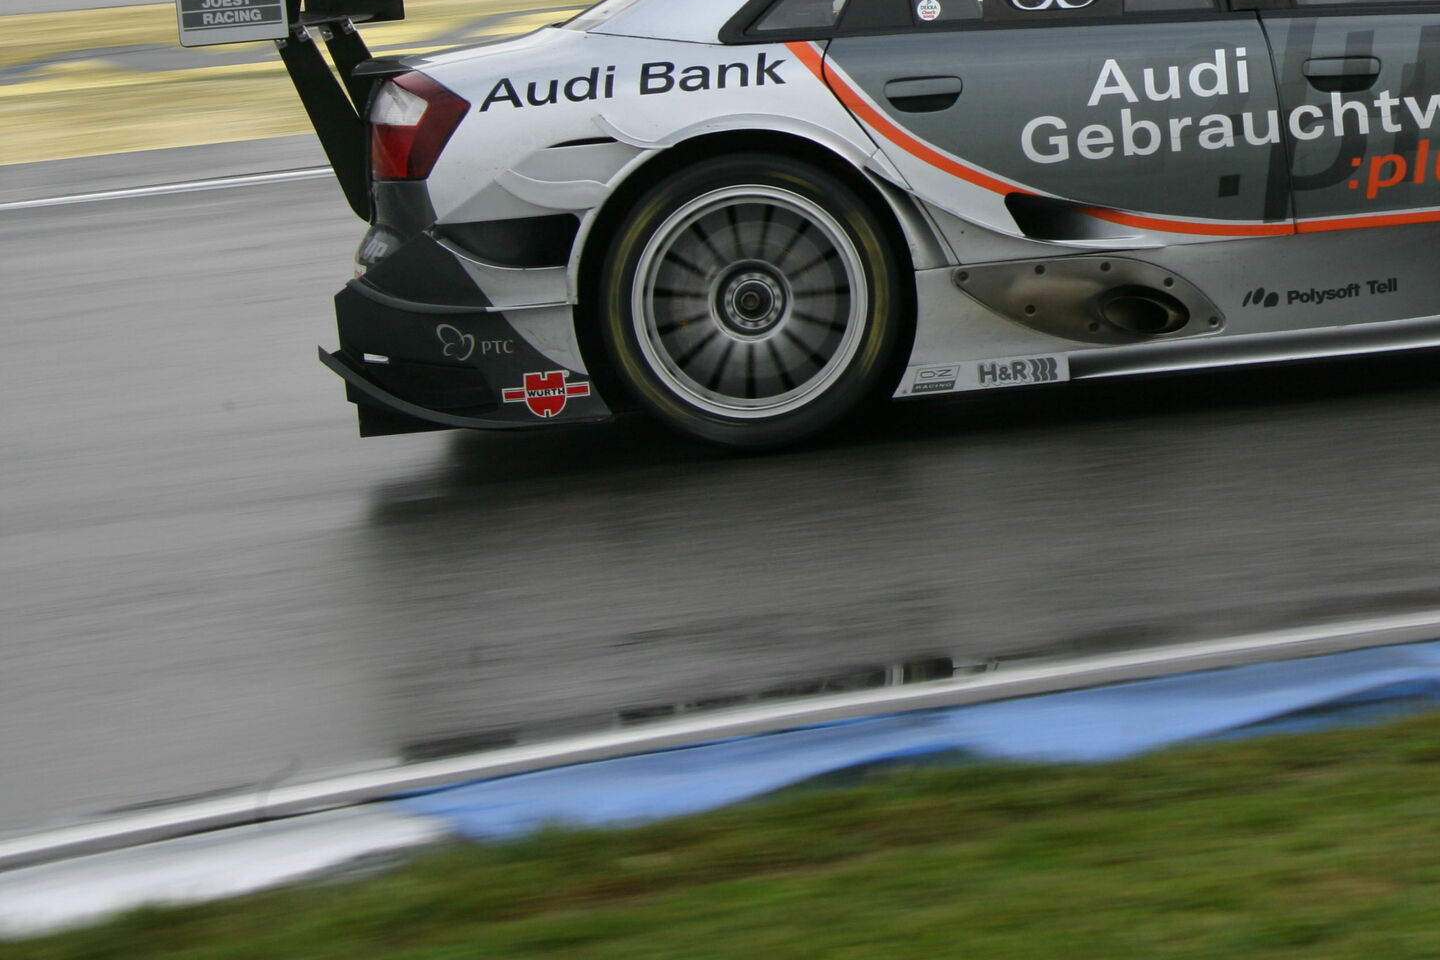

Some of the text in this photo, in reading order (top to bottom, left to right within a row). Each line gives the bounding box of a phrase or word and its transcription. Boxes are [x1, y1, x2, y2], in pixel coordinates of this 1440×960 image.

[202, 8, 262, 25] RACING
[479, 52, 788, 112] Audi Bank
[1087, 47, 1249, 106] Audi
[1287, 278, 1397, 305] Polysoft Tell
[482, 339, 514, 354] PTC
[979, 361, 1027, 384] H&R
